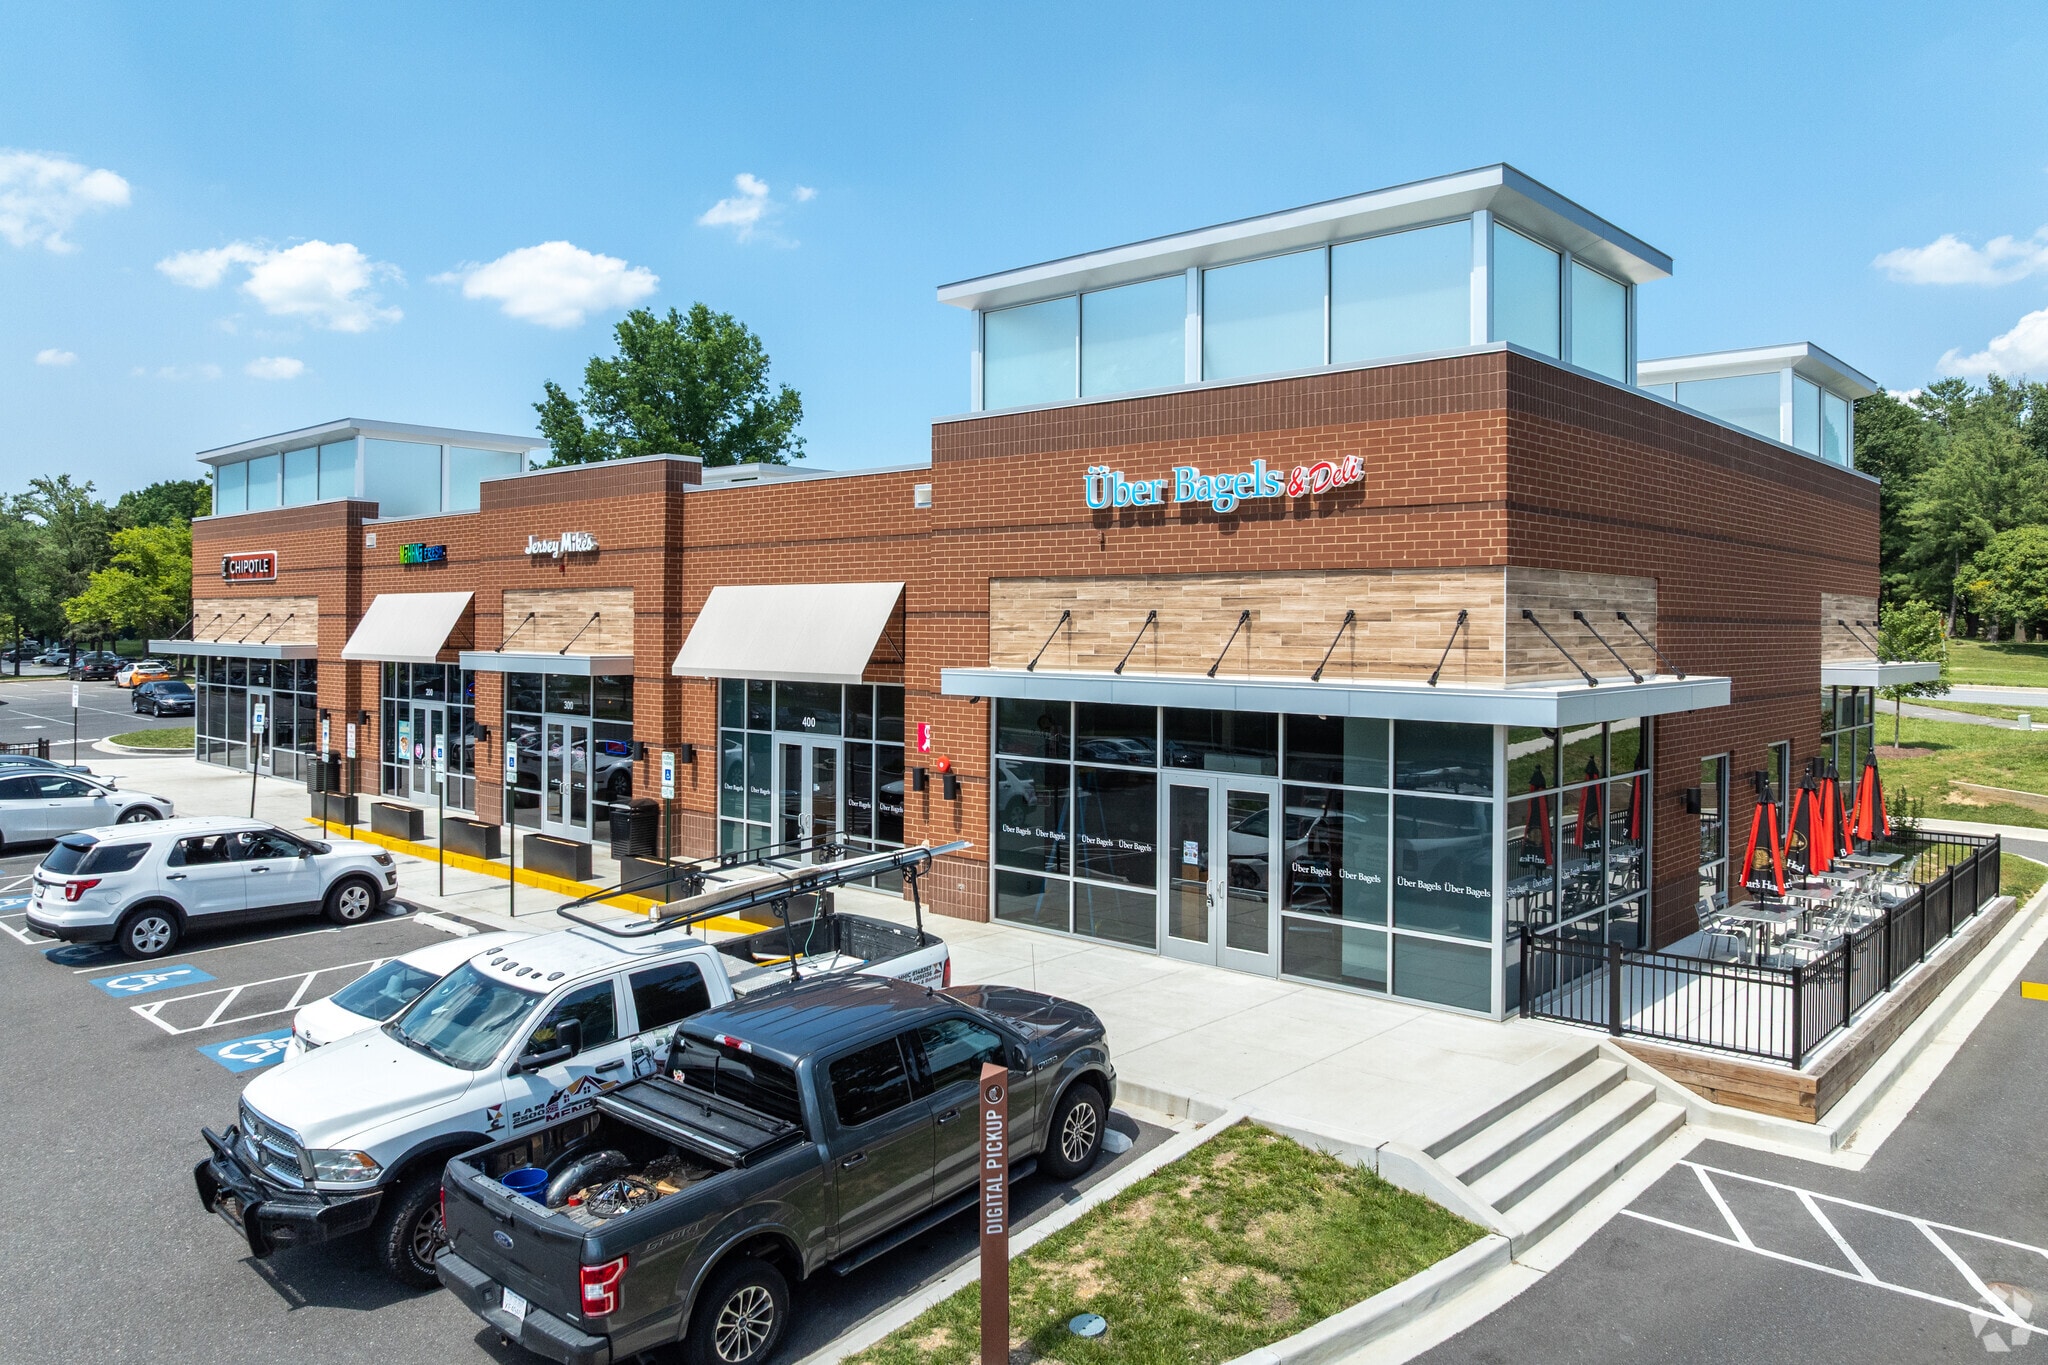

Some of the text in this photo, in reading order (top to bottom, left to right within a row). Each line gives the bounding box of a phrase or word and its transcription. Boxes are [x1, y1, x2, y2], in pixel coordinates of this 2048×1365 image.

[1084, 466, 1167, 509] Über
[1172, 459, 1285, 513] Bagels
[1309, 455, 1364, 493] Deli
[525, 532, 598, 559] Jersey Mike's
[229, 558, 270, 574] CHIPOTLE
[425, 688, 434, 696] 200
[563, 700, 574, 710] 300
[802, 716, 816, 728] 400
[1310, 865, 1332, 878] Bagels
[1358, 873, 1381, 884] Bagels
[1417, 880, 1441, 892] Bagels
[1466, 886, 1491, 899] Bagels
[512, 1103, 545, 1118] RAM
[512, 1110, 546, 1125] 2500
[986, 1109, 1003, 1235] DIGITAL PICKUP
